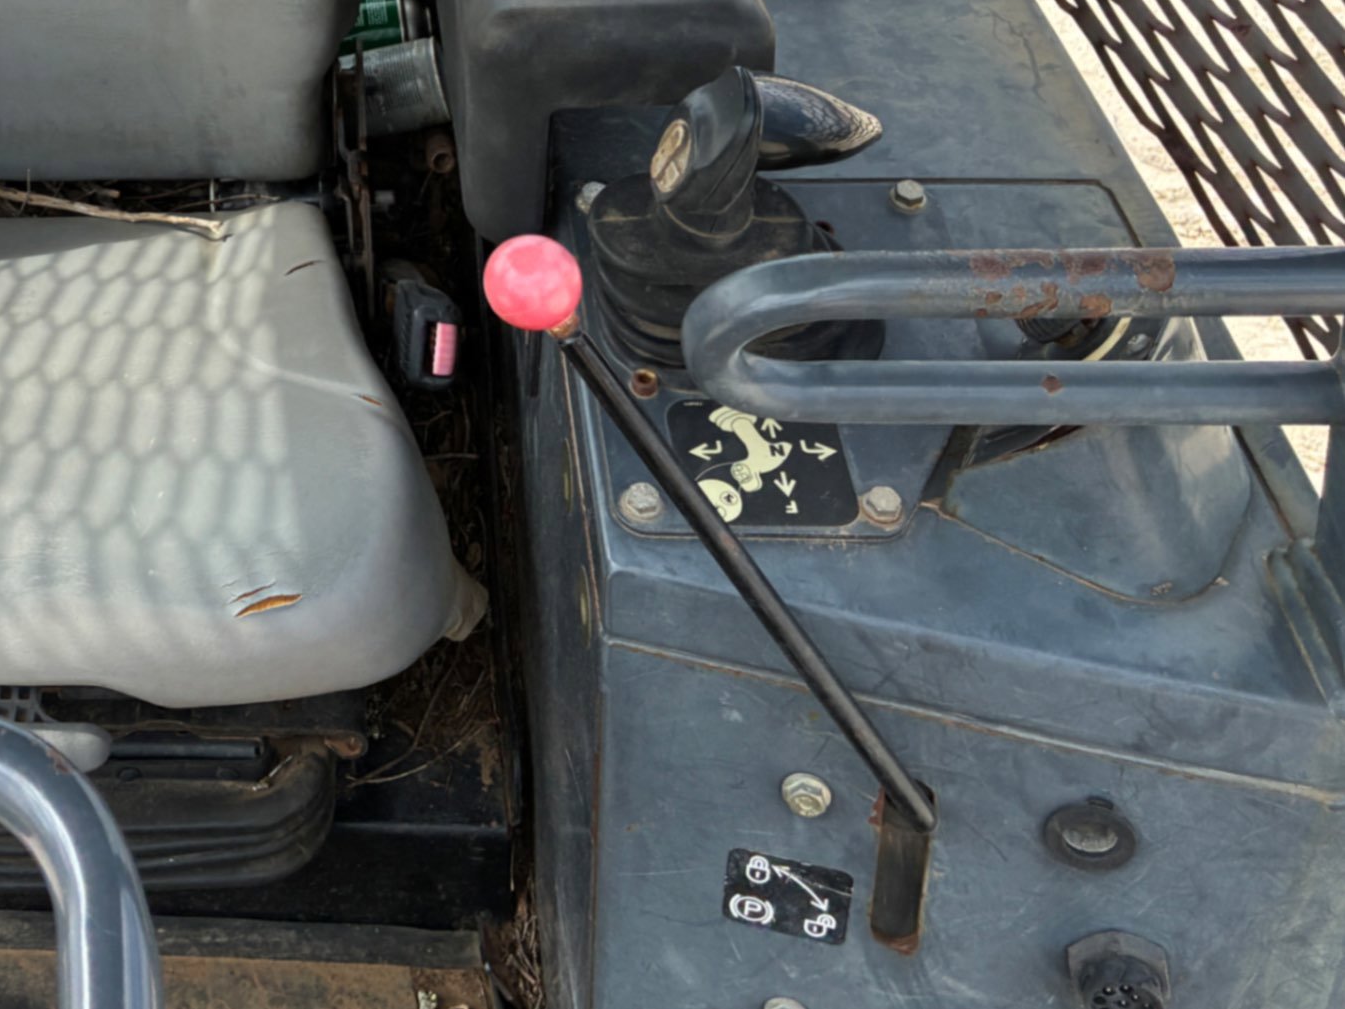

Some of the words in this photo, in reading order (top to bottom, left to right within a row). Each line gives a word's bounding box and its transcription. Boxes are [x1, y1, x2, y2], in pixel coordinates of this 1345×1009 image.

[768, 444, 786, 457] N
[785, 500, 798, 514] F
[744, 902, 762, 916] P
